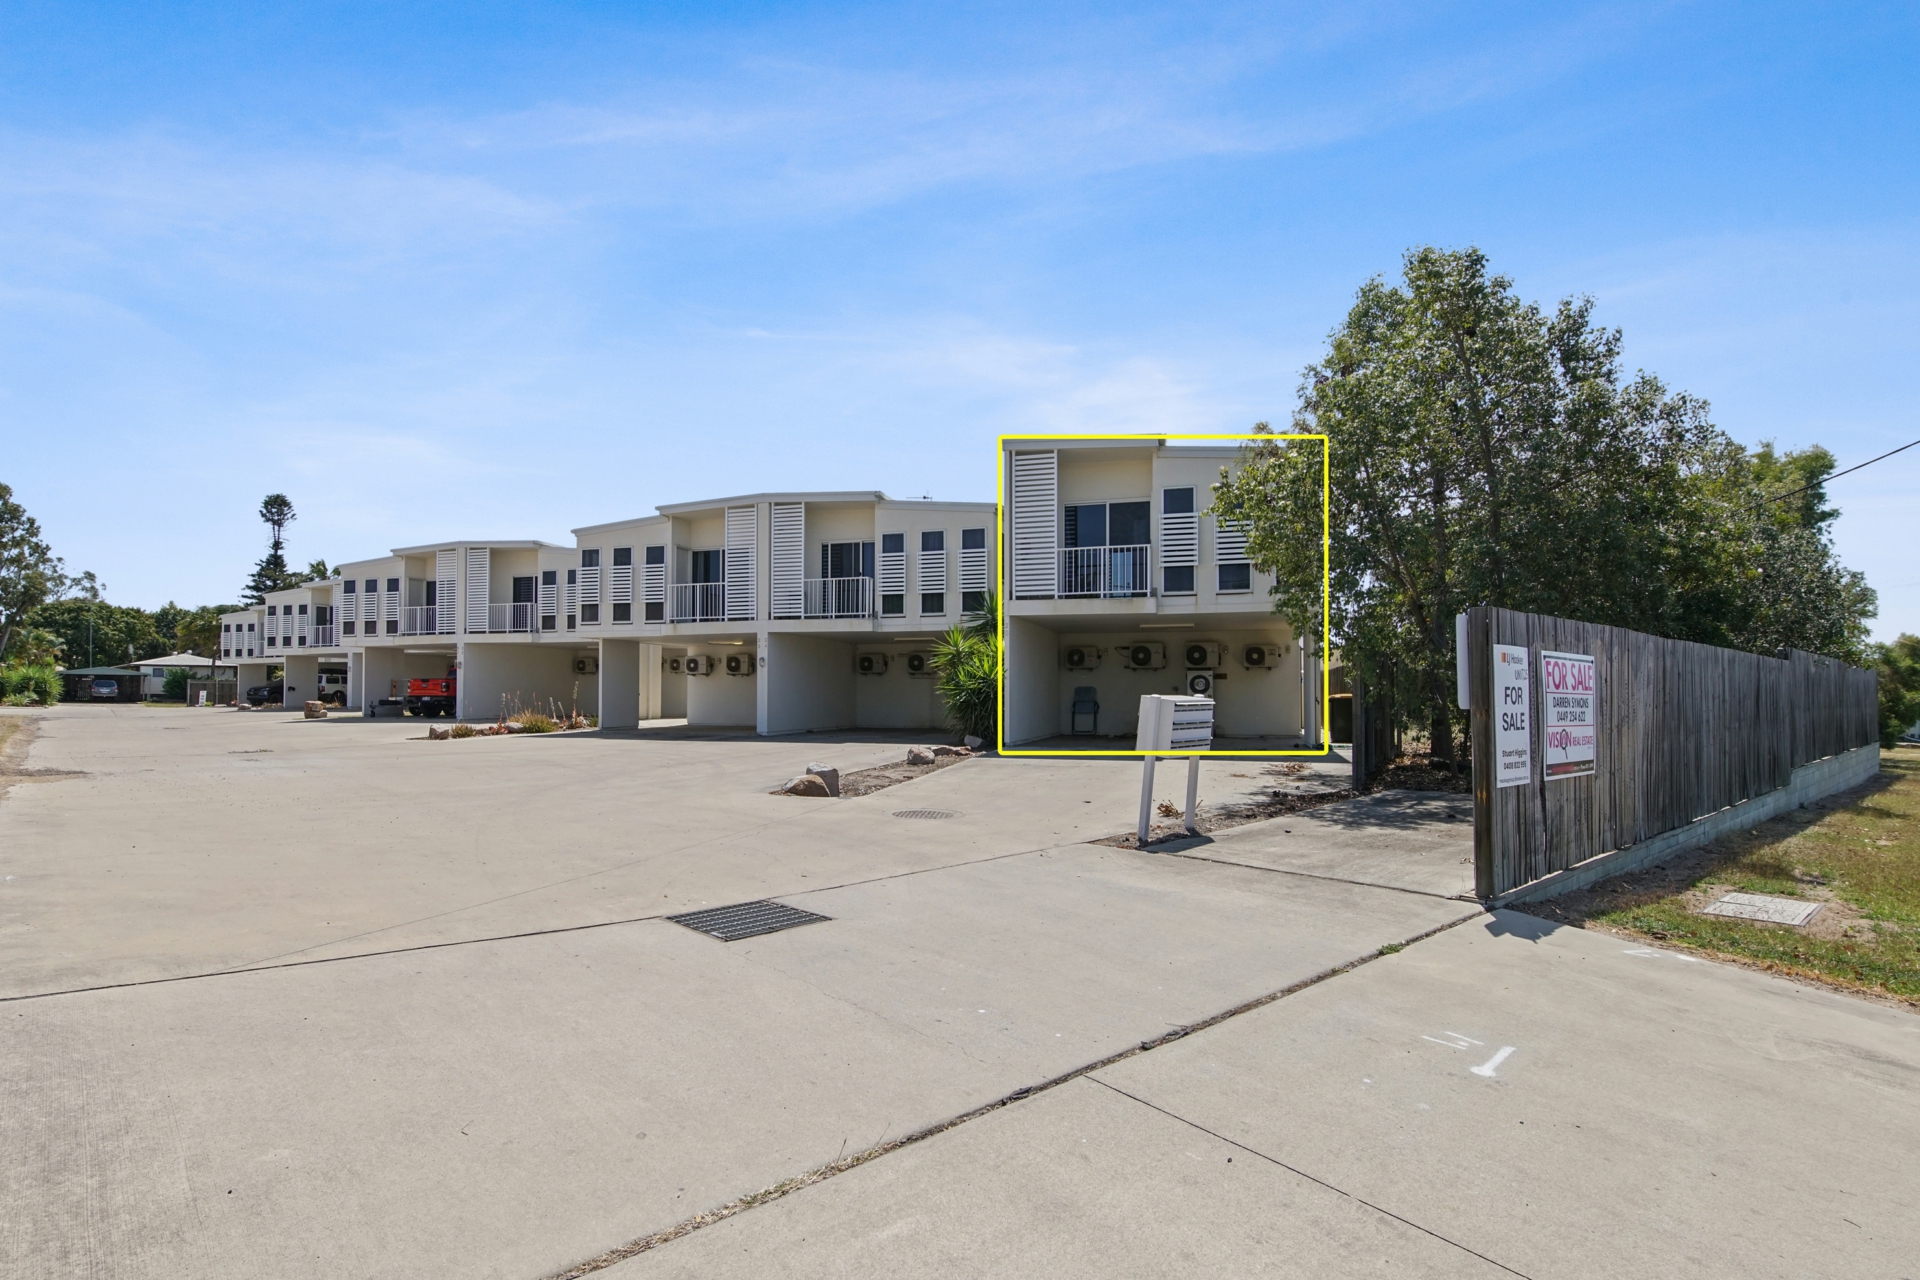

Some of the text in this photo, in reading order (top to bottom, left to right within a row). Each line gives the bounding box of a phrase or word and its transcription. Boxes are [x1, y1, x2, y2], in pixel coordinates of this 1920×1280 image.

[1545, 660, 1592, 692] FOR SALE
[1504, 686, 1523, 705] FOR
[1553, 696, 1589, 709] DARREN SYMONS
[1502, 712, 1525, 731] SALE
[1556, 710, 1586, 722] 0449 254 622
[1547, 729, 1594, 750] VISION REAL ESTATE
[1502, 748, 1527, 759] Stuart Higgins
